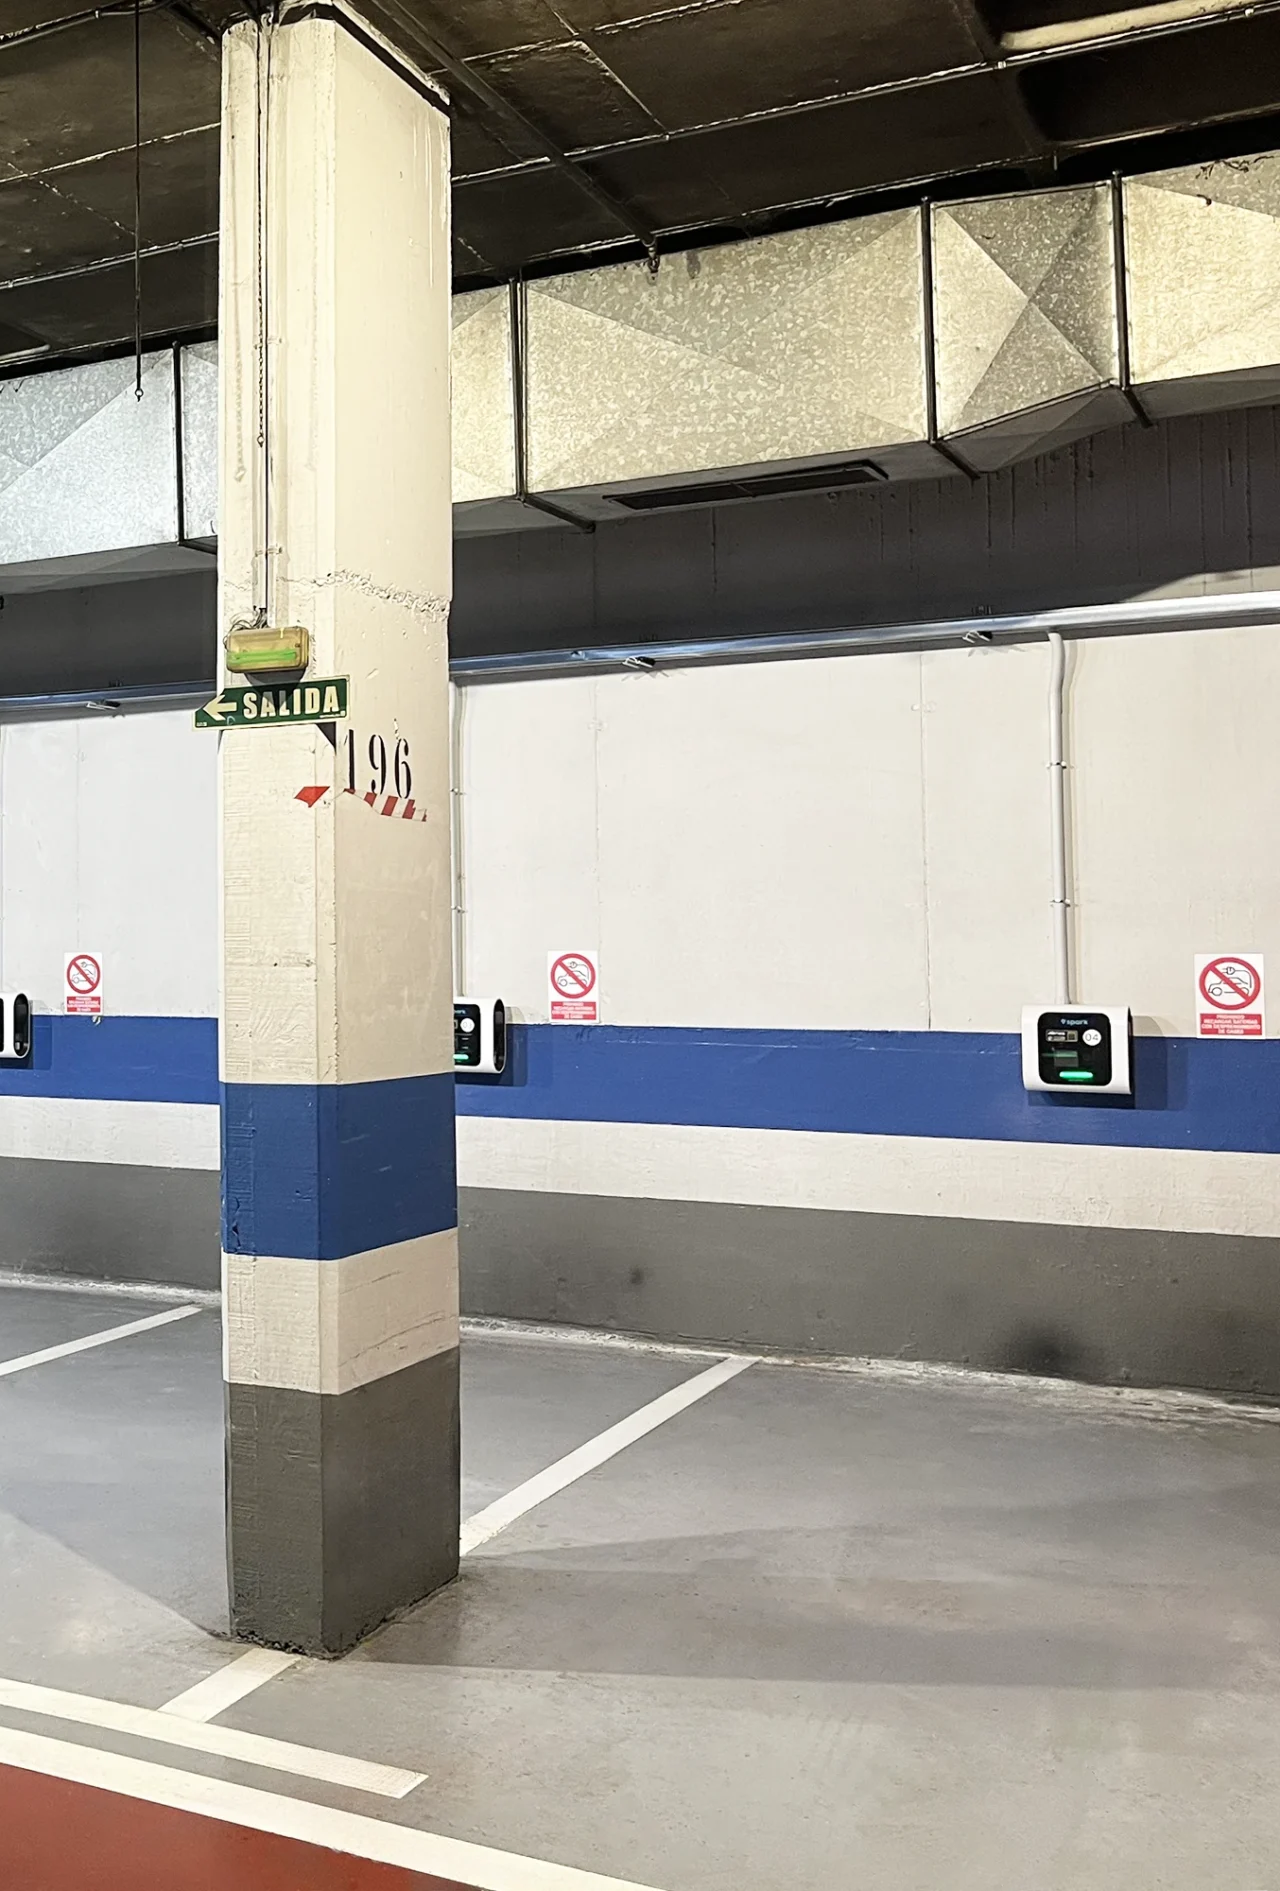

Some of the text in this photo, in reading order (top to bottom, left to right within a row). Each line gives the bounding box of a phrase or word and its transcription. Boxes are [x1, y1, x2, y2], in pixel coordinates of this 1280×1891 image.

[243, 685, 340, 720] SALIDA
[344, 729, 412, 799] 196
[1085, 1033, 1099, 1041] 04
